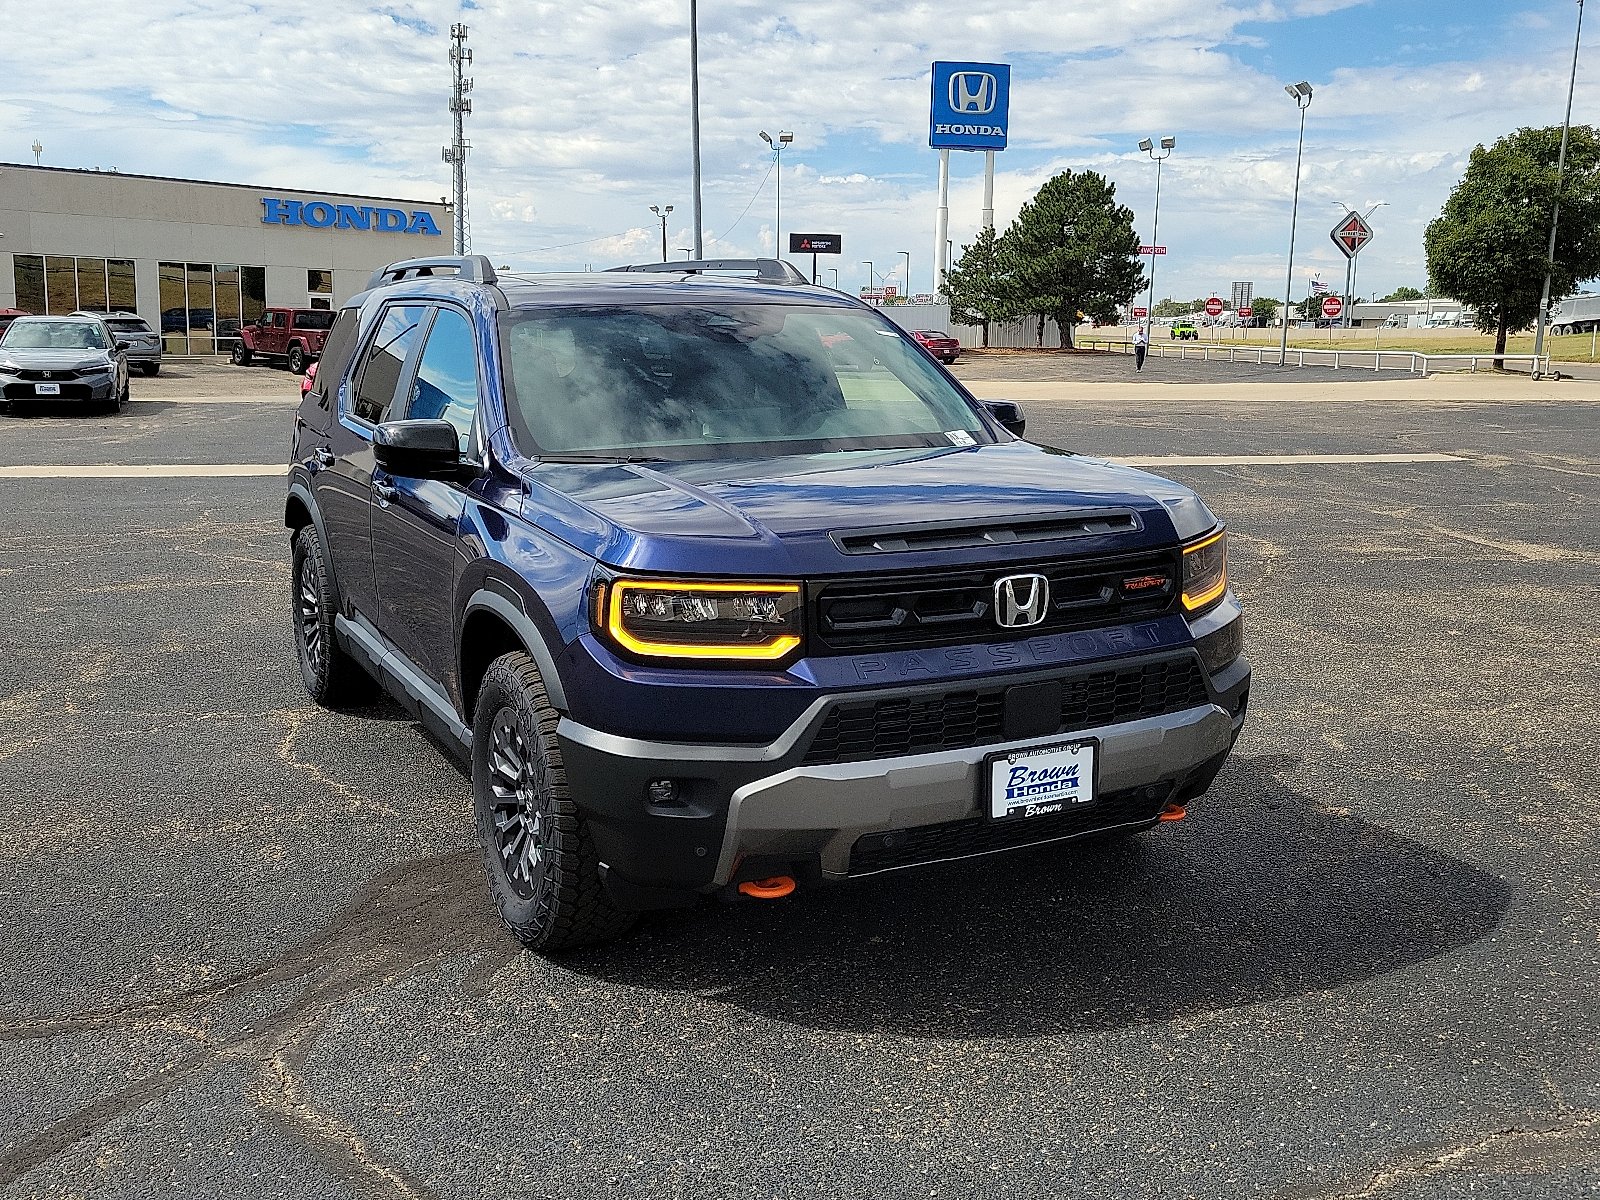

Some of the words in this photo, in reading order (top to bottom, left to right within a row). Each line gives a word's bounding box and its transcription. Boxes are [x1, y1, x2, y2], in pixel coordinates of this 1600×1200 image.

[935, 124, 1005, 136] HONDA
[261, 198, 441, 236] HONDA
[852, 623, 1159, 679] PASSPORT
[1007, 763, 1080, 788] Brown
[1013, 780, 1072, 797] Honda
[1025, 803, 1063, 817] Brown
